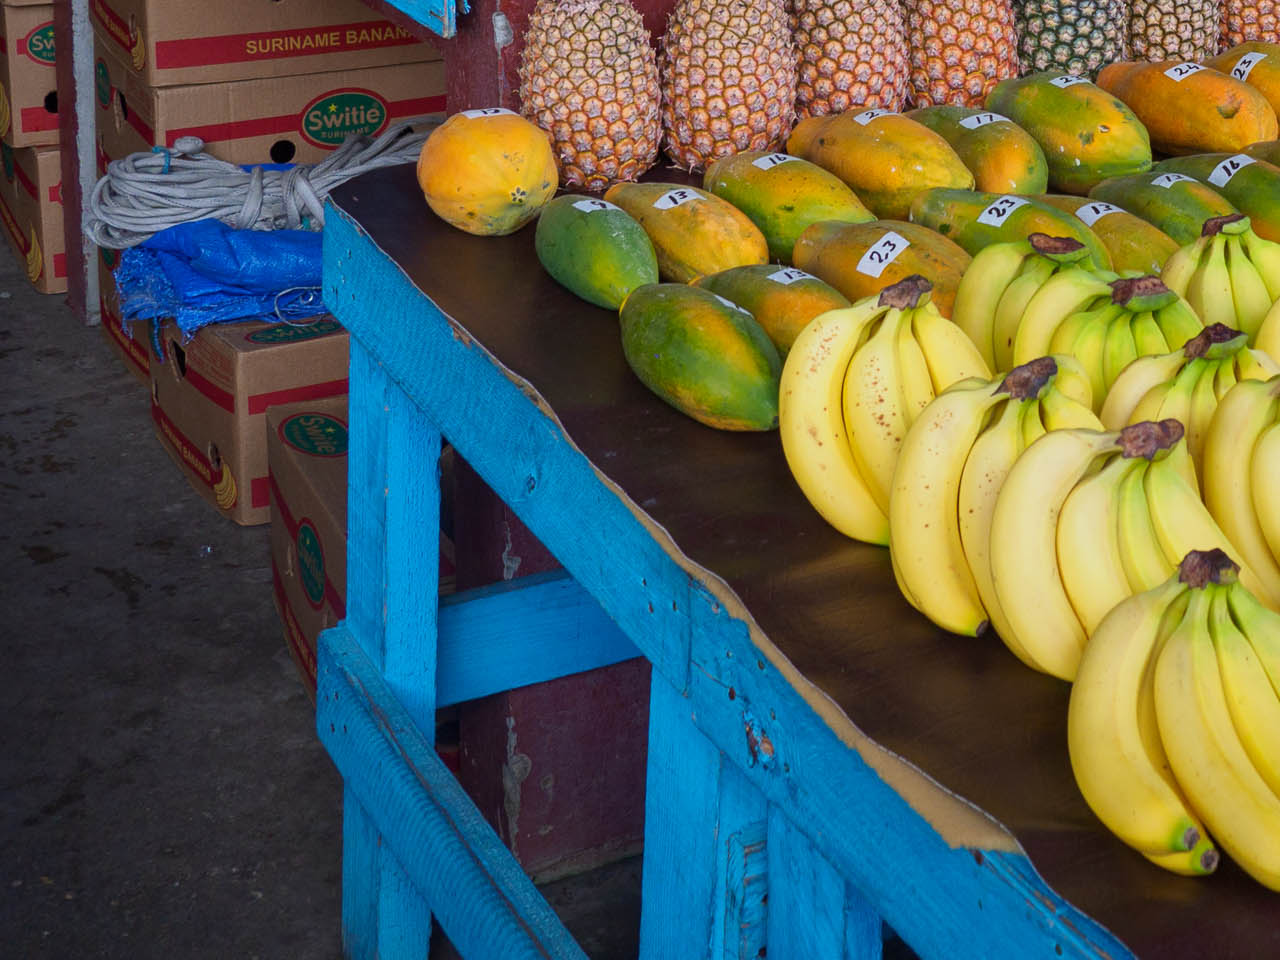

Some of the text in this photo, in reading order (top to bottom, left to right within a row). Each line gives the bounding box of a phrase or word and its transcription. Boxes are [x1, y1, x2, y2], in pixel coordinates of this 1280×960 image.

[245, 30, 341, 55] SURINAME
[1233, 58, 1253, 80] 23
[308, 104, 381, 131] Switie
[667, 190, 689, 206] 13
[987, 198, 1016, 218] 23
